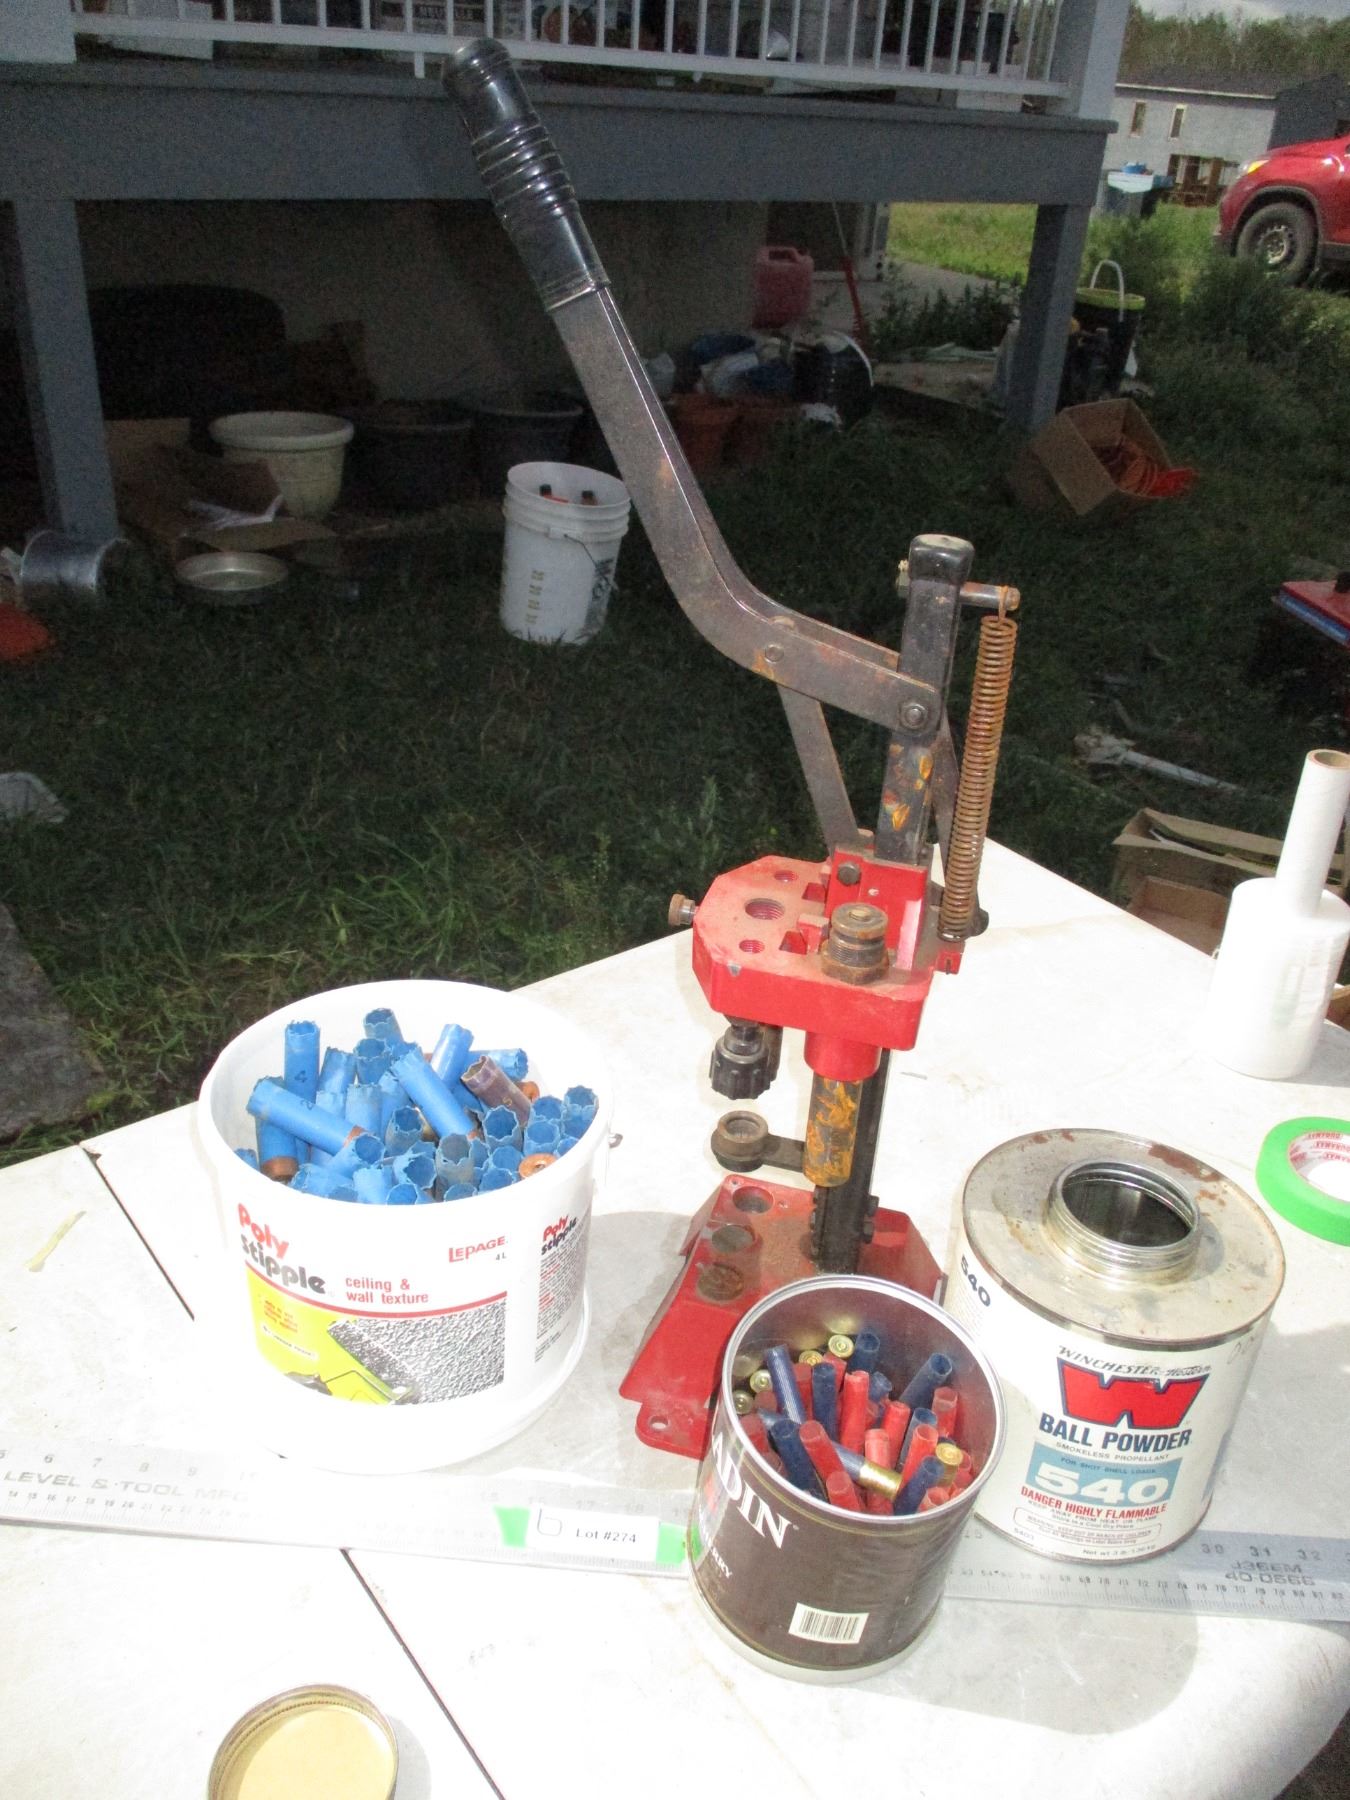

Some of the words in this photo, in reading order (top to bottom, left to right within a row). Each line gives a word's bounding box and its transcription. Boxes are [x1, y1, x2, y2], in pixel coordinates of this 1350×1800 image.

[238, 1203, 289, 1260] Poly
[345, 1277, 392, 1293] ceiling
[400, 1278, 410, 1291] &
[961, 1253, 991, 1308] 540
[346, 1291, 374, 1304] wall
[381, 1292, 429, 1305] texture
[1038, 1412, 1093, 1448] BALL
[1101, 1428, 1192, 1454] POWDER
[1056, 1442, 1110, 1459] SMOKELESS
[1114, 1453, 1169, 1462] PROPELLANT
[4, 1470, 80, 1487] LEVEL
[121, 1480, 184, 1497] TOOL
[1034, 1462, 1169, 1504] 540
[1020, 1486, 1063, 1510] DANGER
[1065, 1502, 1103, 1518] HIGHLY
[1105, 1503, 1169, 1520] FLAMMABLE
[576, 1528, 599, 1540] Lot
[603, 1531, 637, 1544] #274
